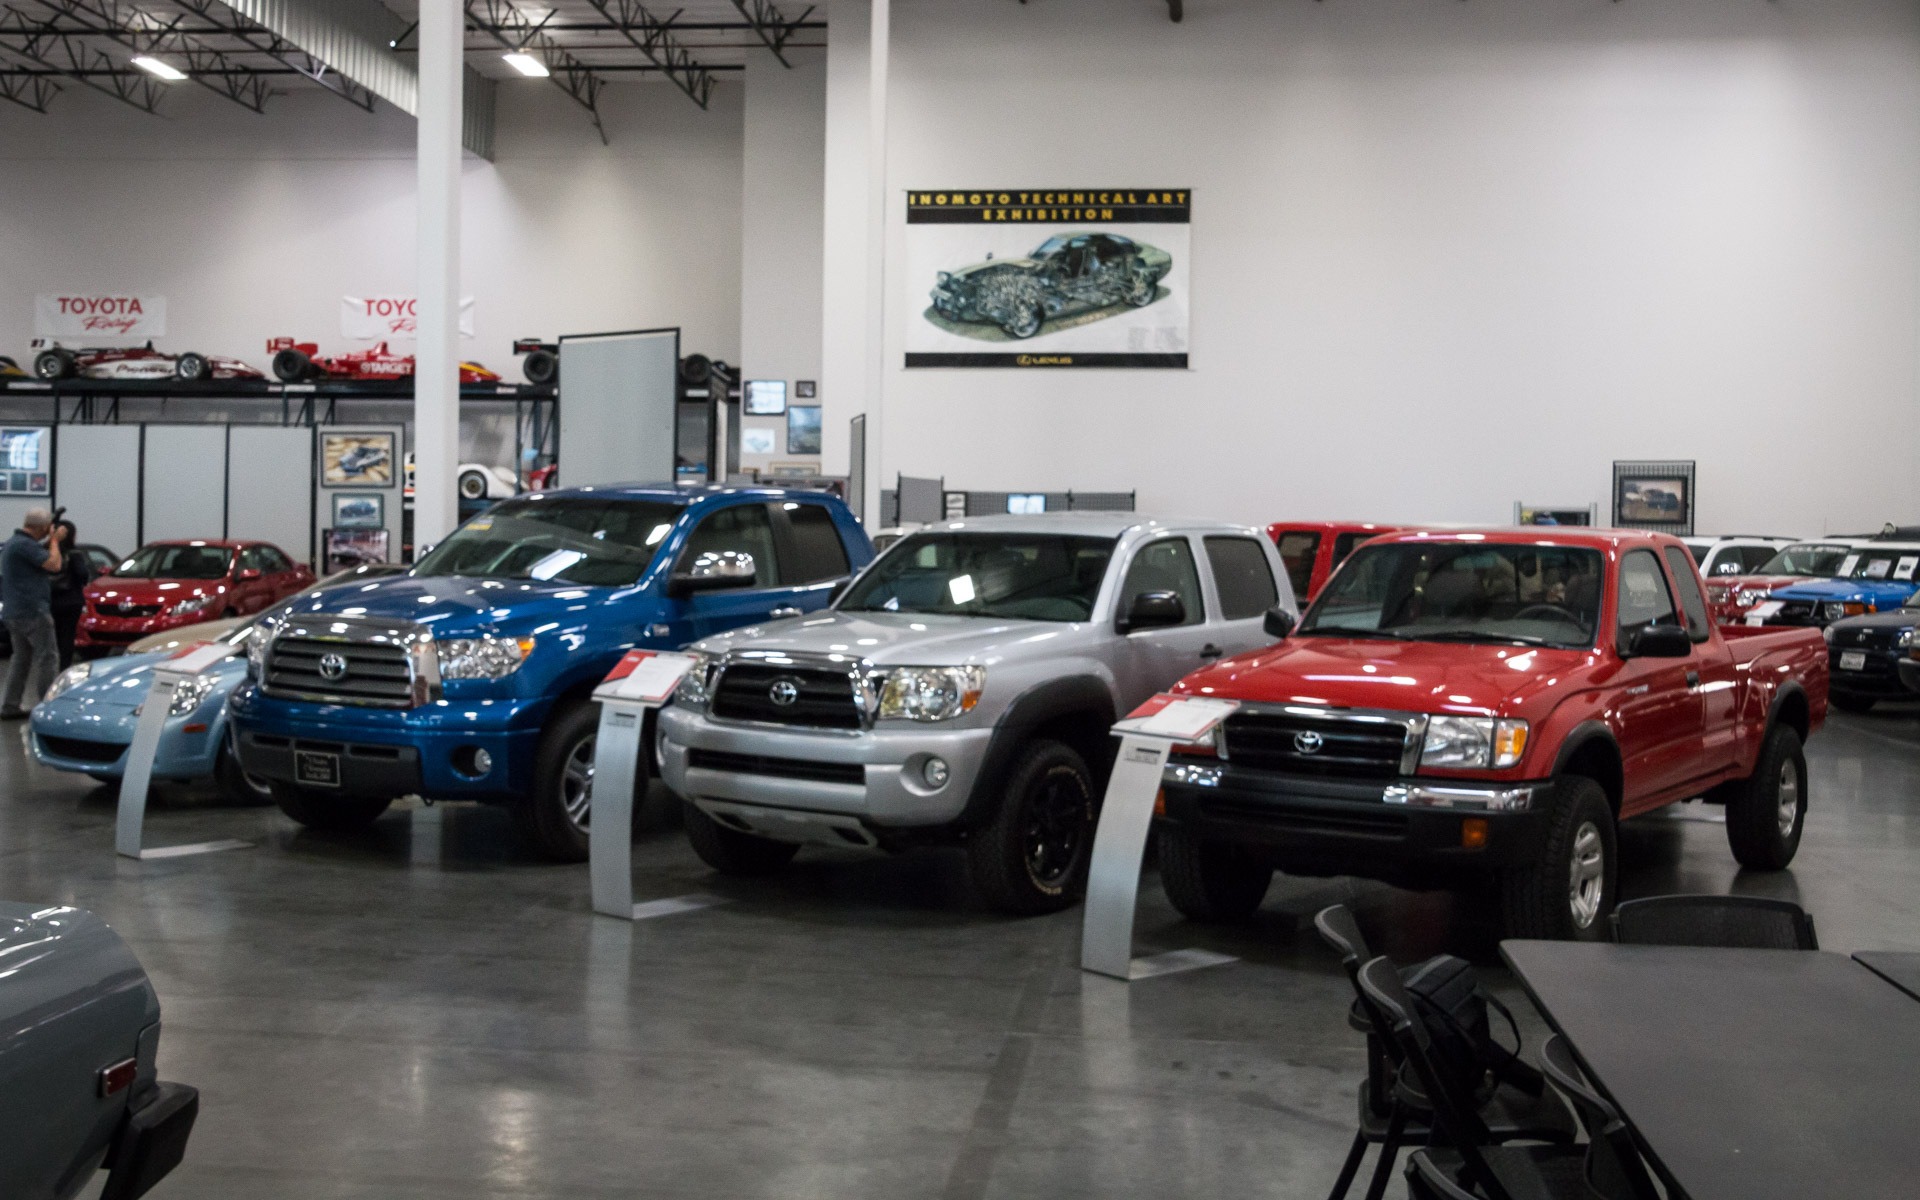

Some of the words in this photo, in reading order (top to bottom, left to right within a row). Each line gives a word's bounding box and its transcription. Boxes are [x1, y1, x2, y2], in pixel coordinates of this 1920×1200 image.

[909, 192, 1011, 206] INOMOTO
[1019, 192, 1138, 205] TECHNICAL
[1145, 192, 1186, 205] ART
[983, 208, 1114, 221] EXHIBITION
[57, 297, 144, 315] TOYOTA
